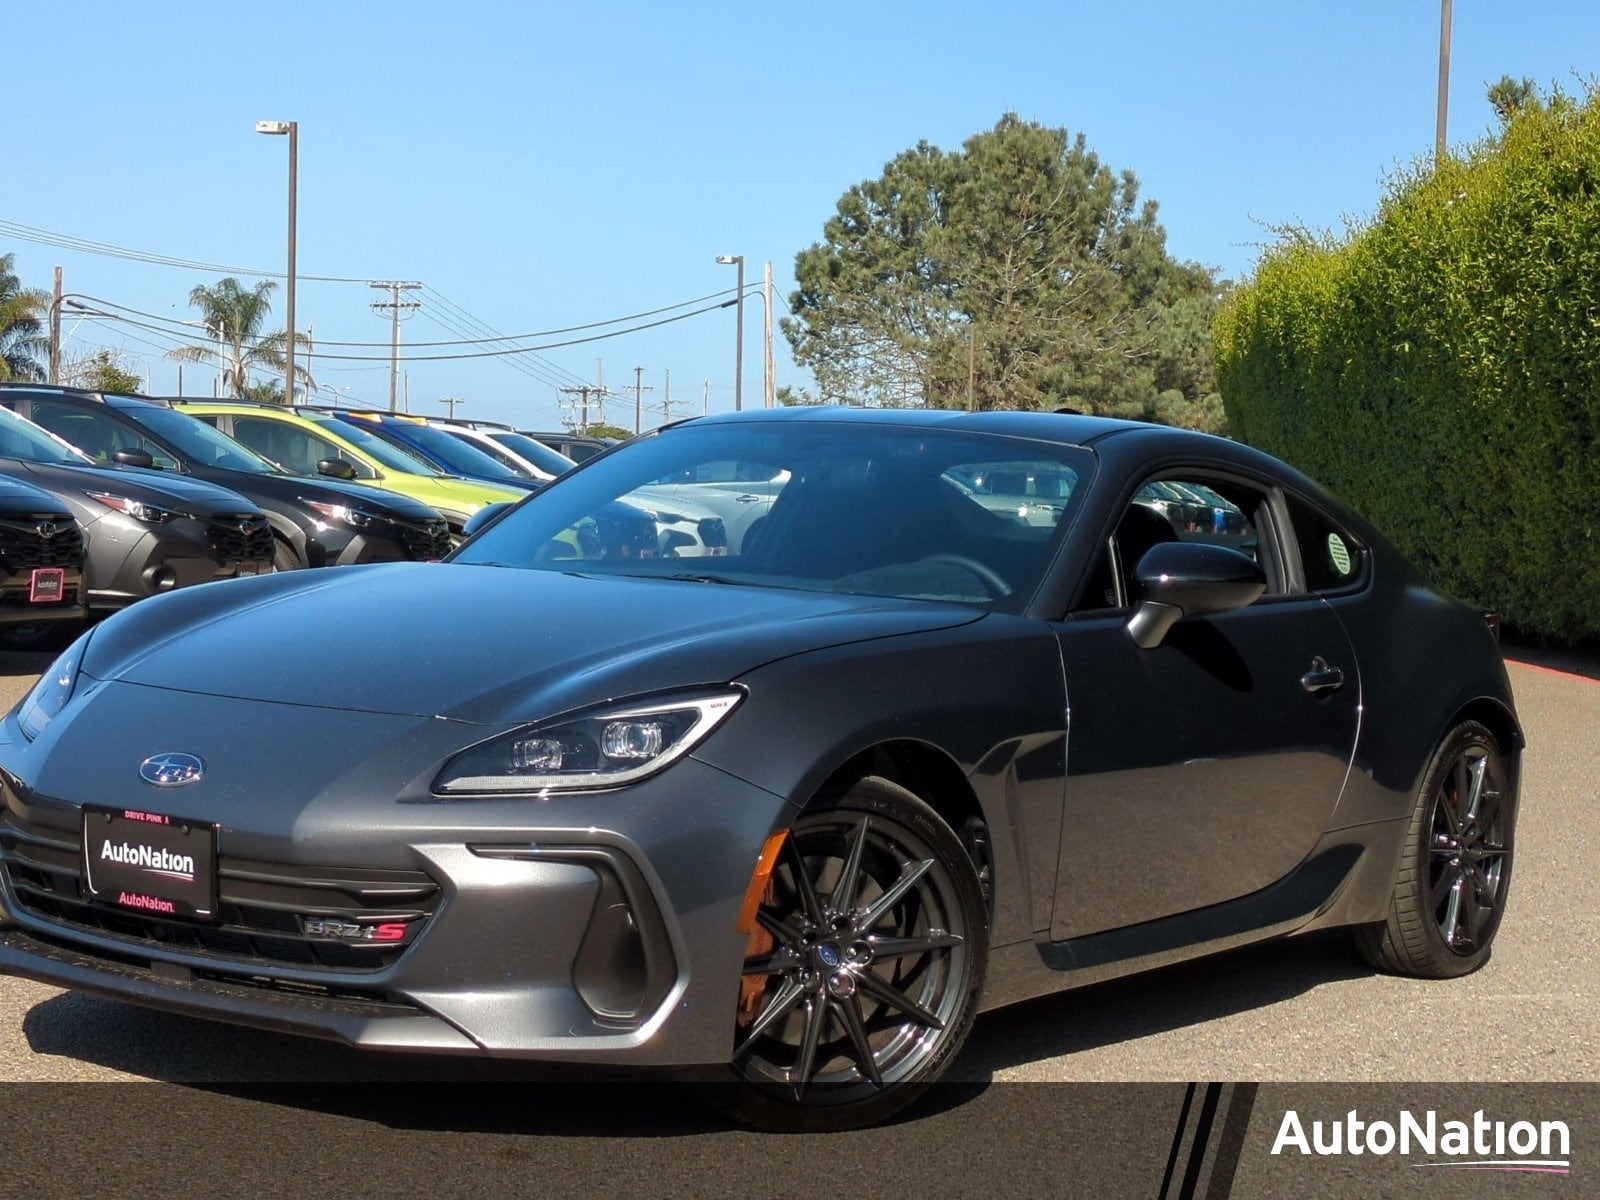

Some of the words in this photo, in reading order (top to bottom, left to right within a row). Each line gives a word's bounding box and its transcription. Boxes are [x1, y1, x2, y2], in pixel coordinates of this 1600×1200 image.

[124, 810, 144, 820] DRIVE
[145, 813, 162, 823] PINK
[101, 839, 194, 873] AutoNation
[119, 891, 173, 912] AutoNation
